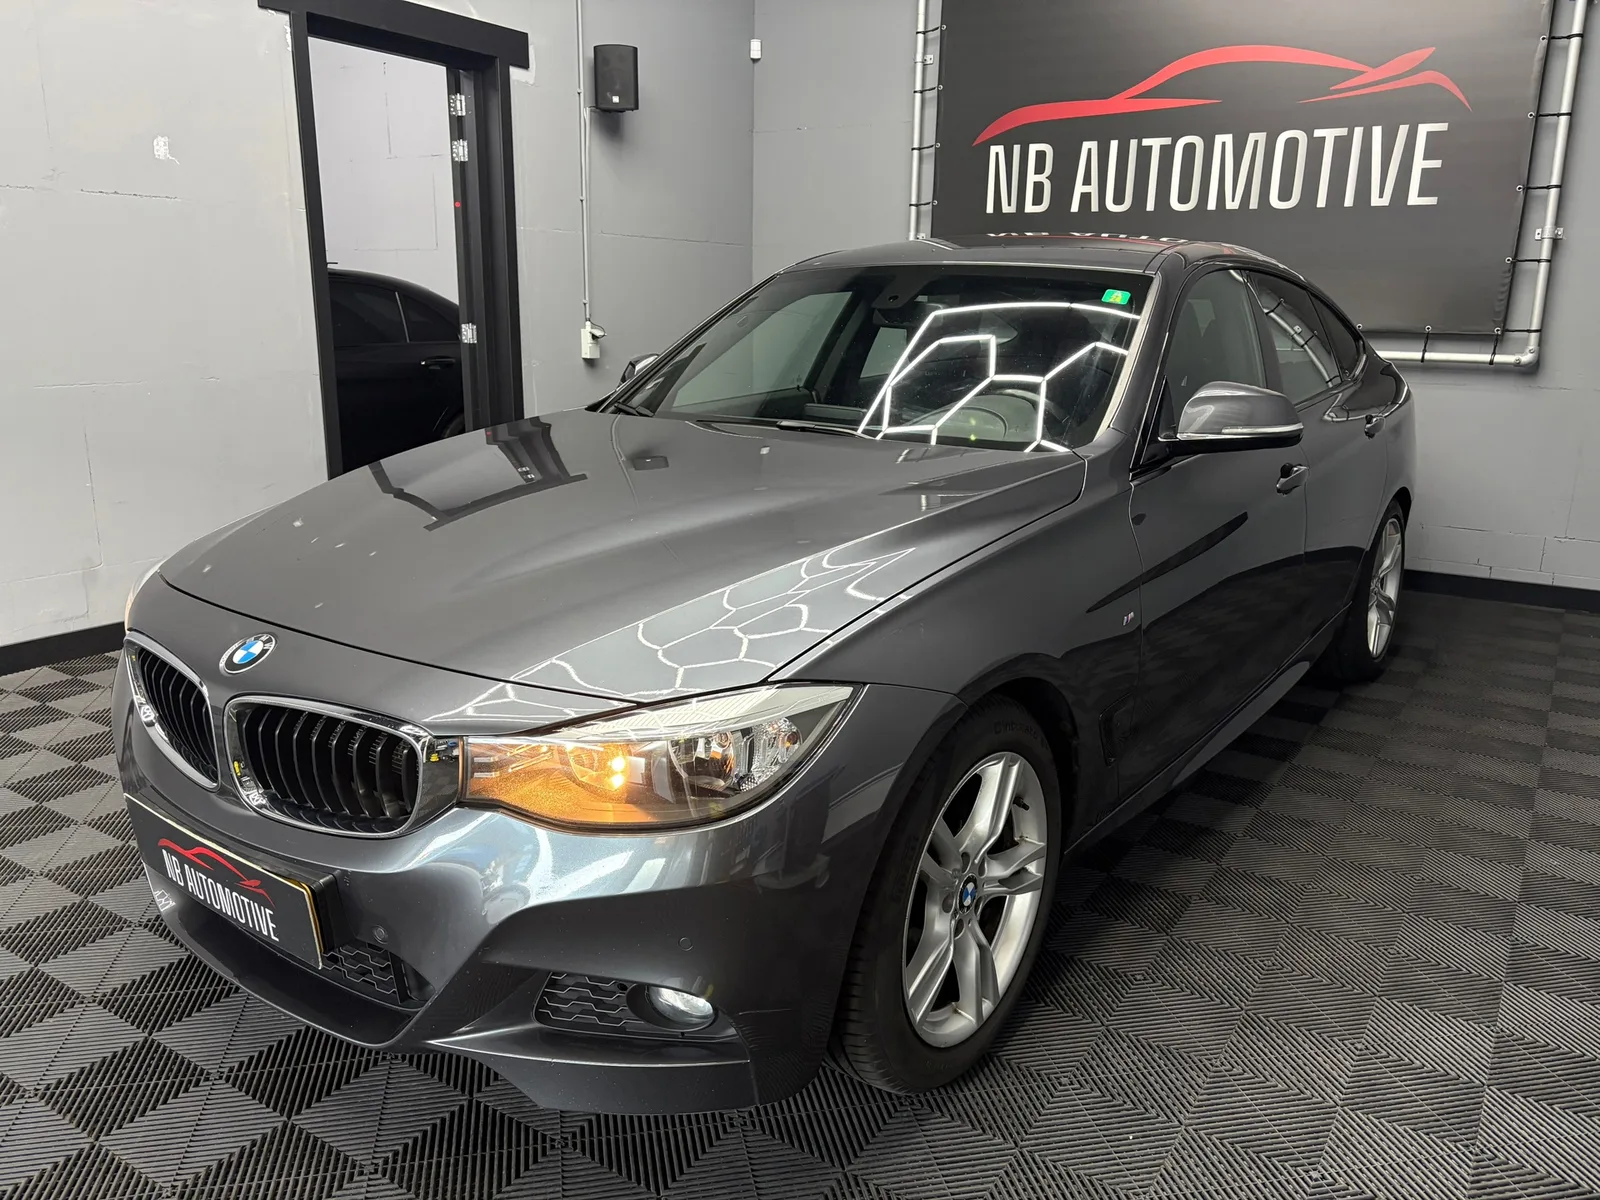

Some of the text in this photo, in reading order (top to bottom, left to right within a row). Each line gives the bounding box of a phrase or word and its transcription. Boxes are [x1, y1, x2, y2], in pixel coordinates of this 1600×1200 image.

[985, 122, 1449, 214] NB AUTOMOTIVE
[162, 848, 280, 942] NB AUTOMOTIVE
